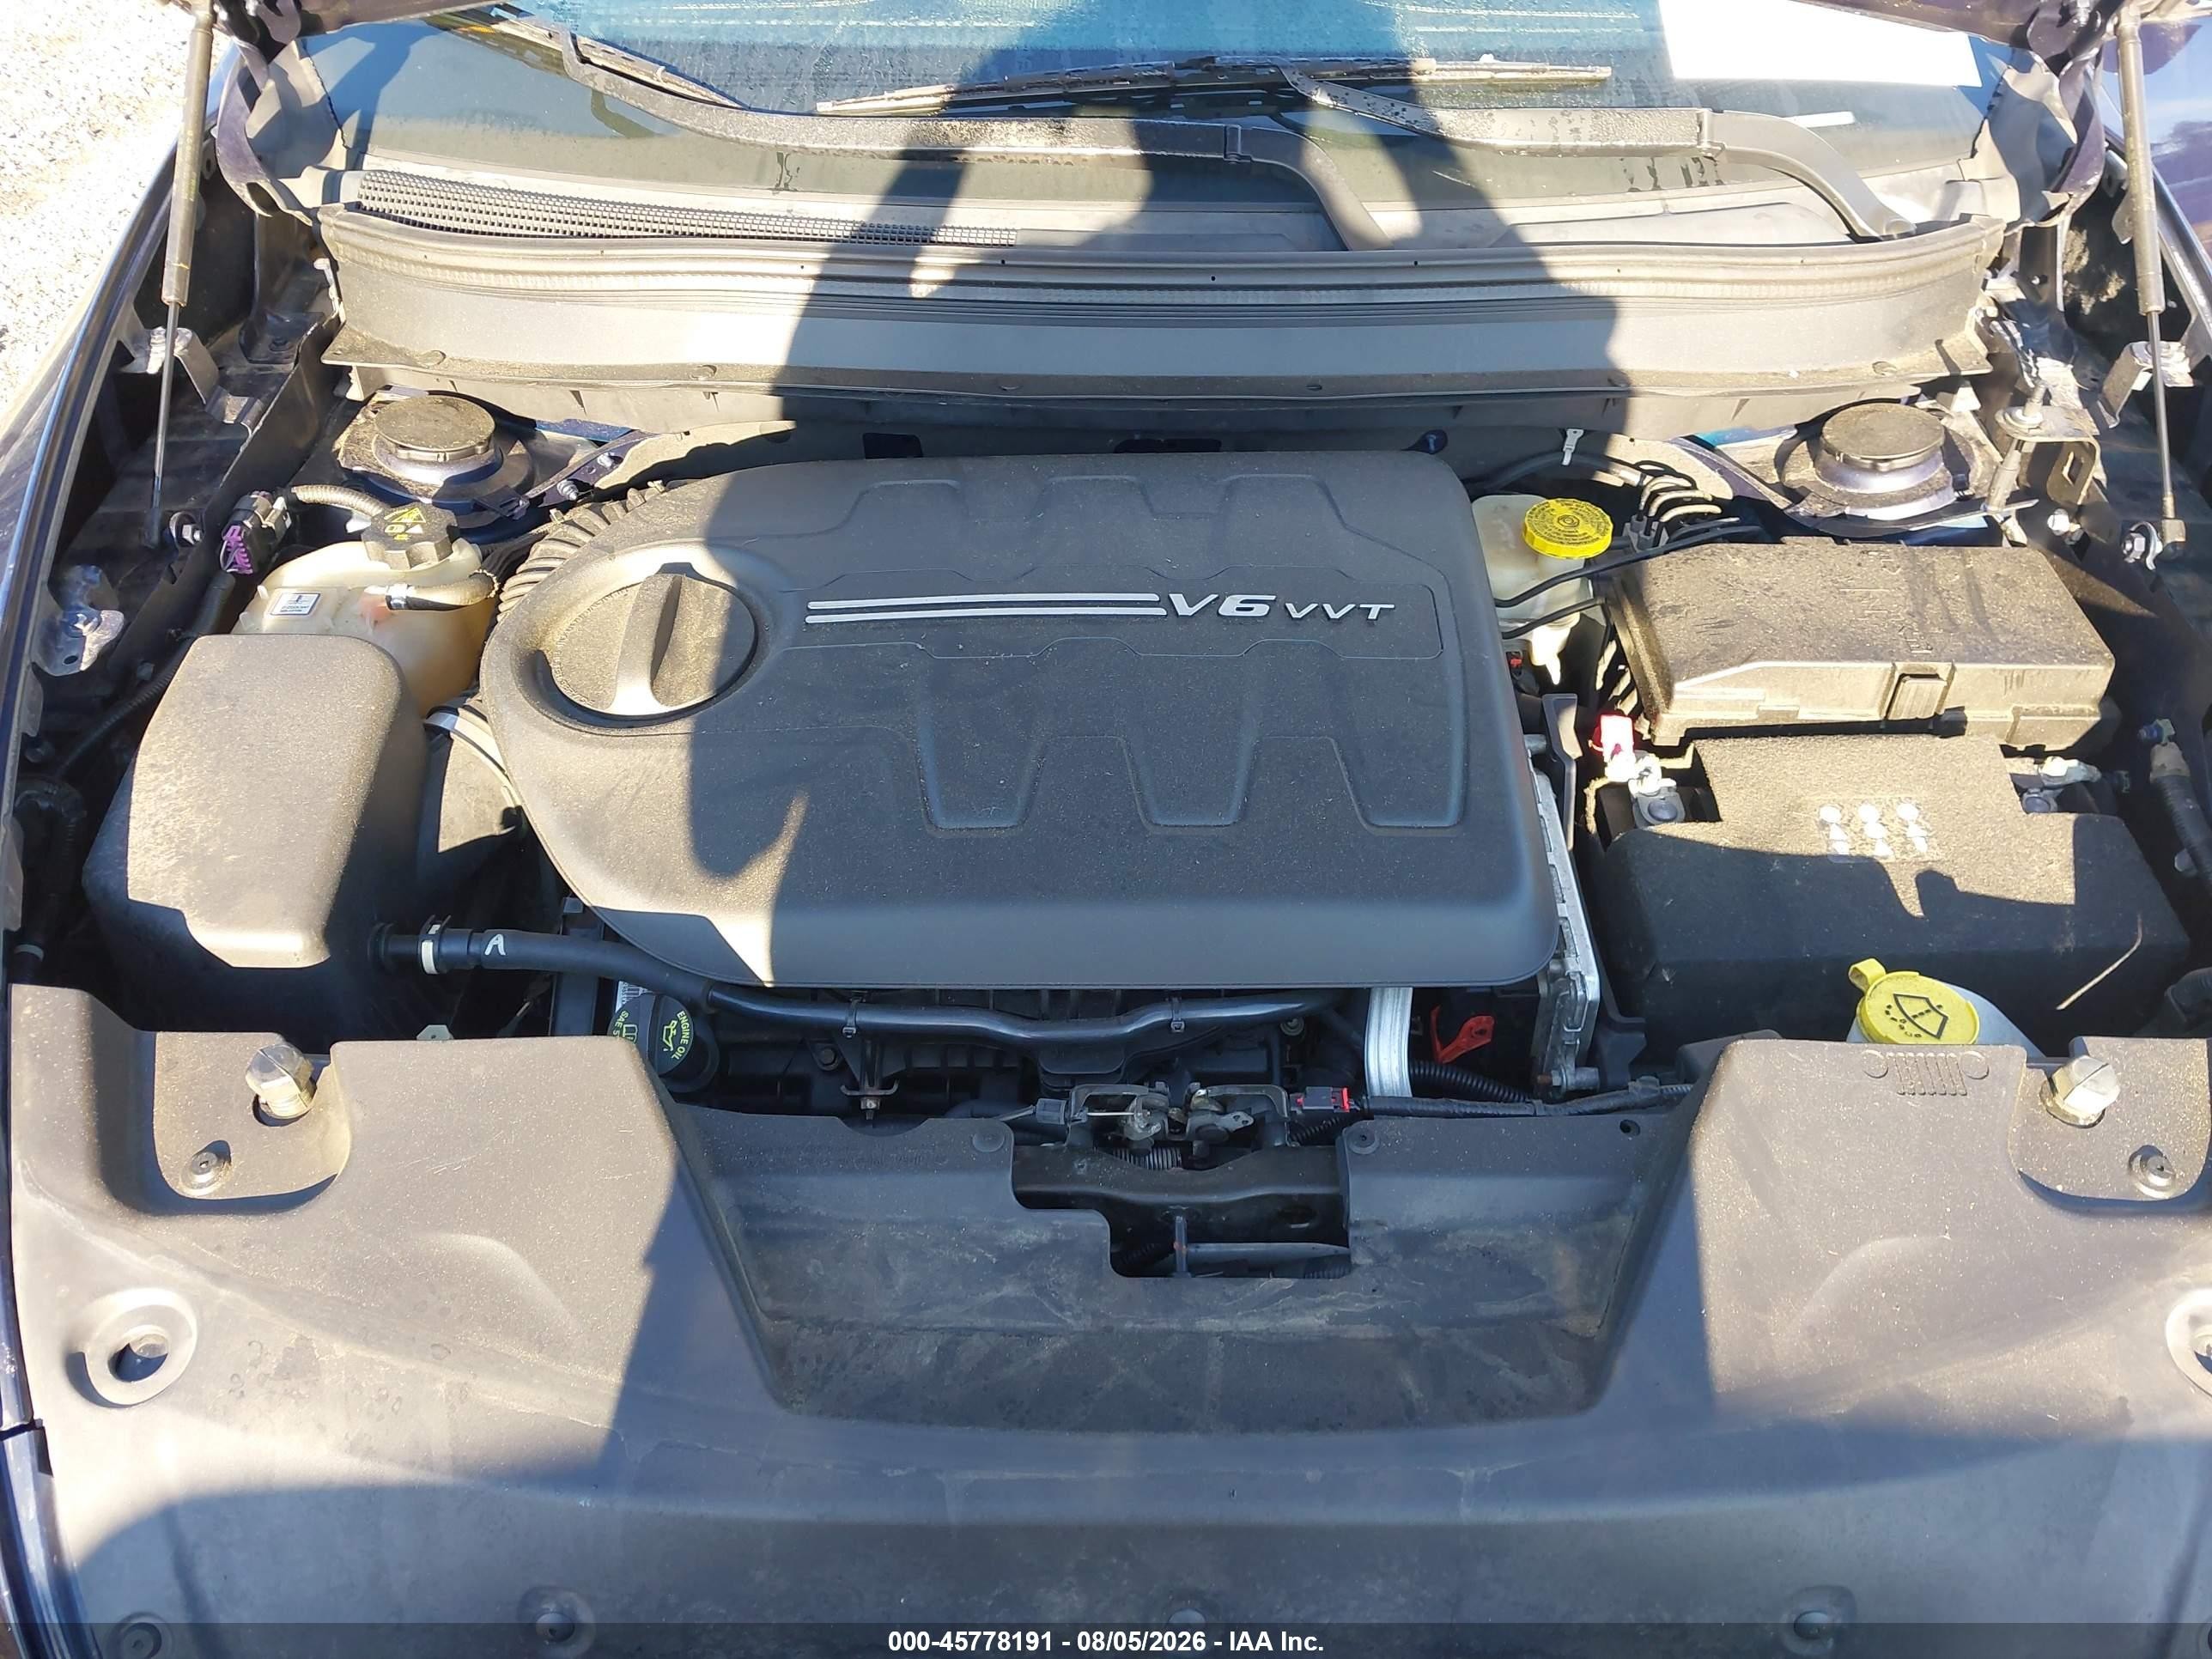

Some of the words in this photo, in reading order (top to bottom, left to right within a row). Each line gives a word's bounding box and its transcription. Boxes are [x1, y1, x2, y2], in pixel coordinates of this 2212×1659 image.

[1168, 593, 1277, 617] V6
[1285, 603, 1395, 620] VVT
[614, 1011, 629, 1029] SAE
[677, 1010, 690, 1045] ENGINE
[671, 1046, 686, 1060] OIL
